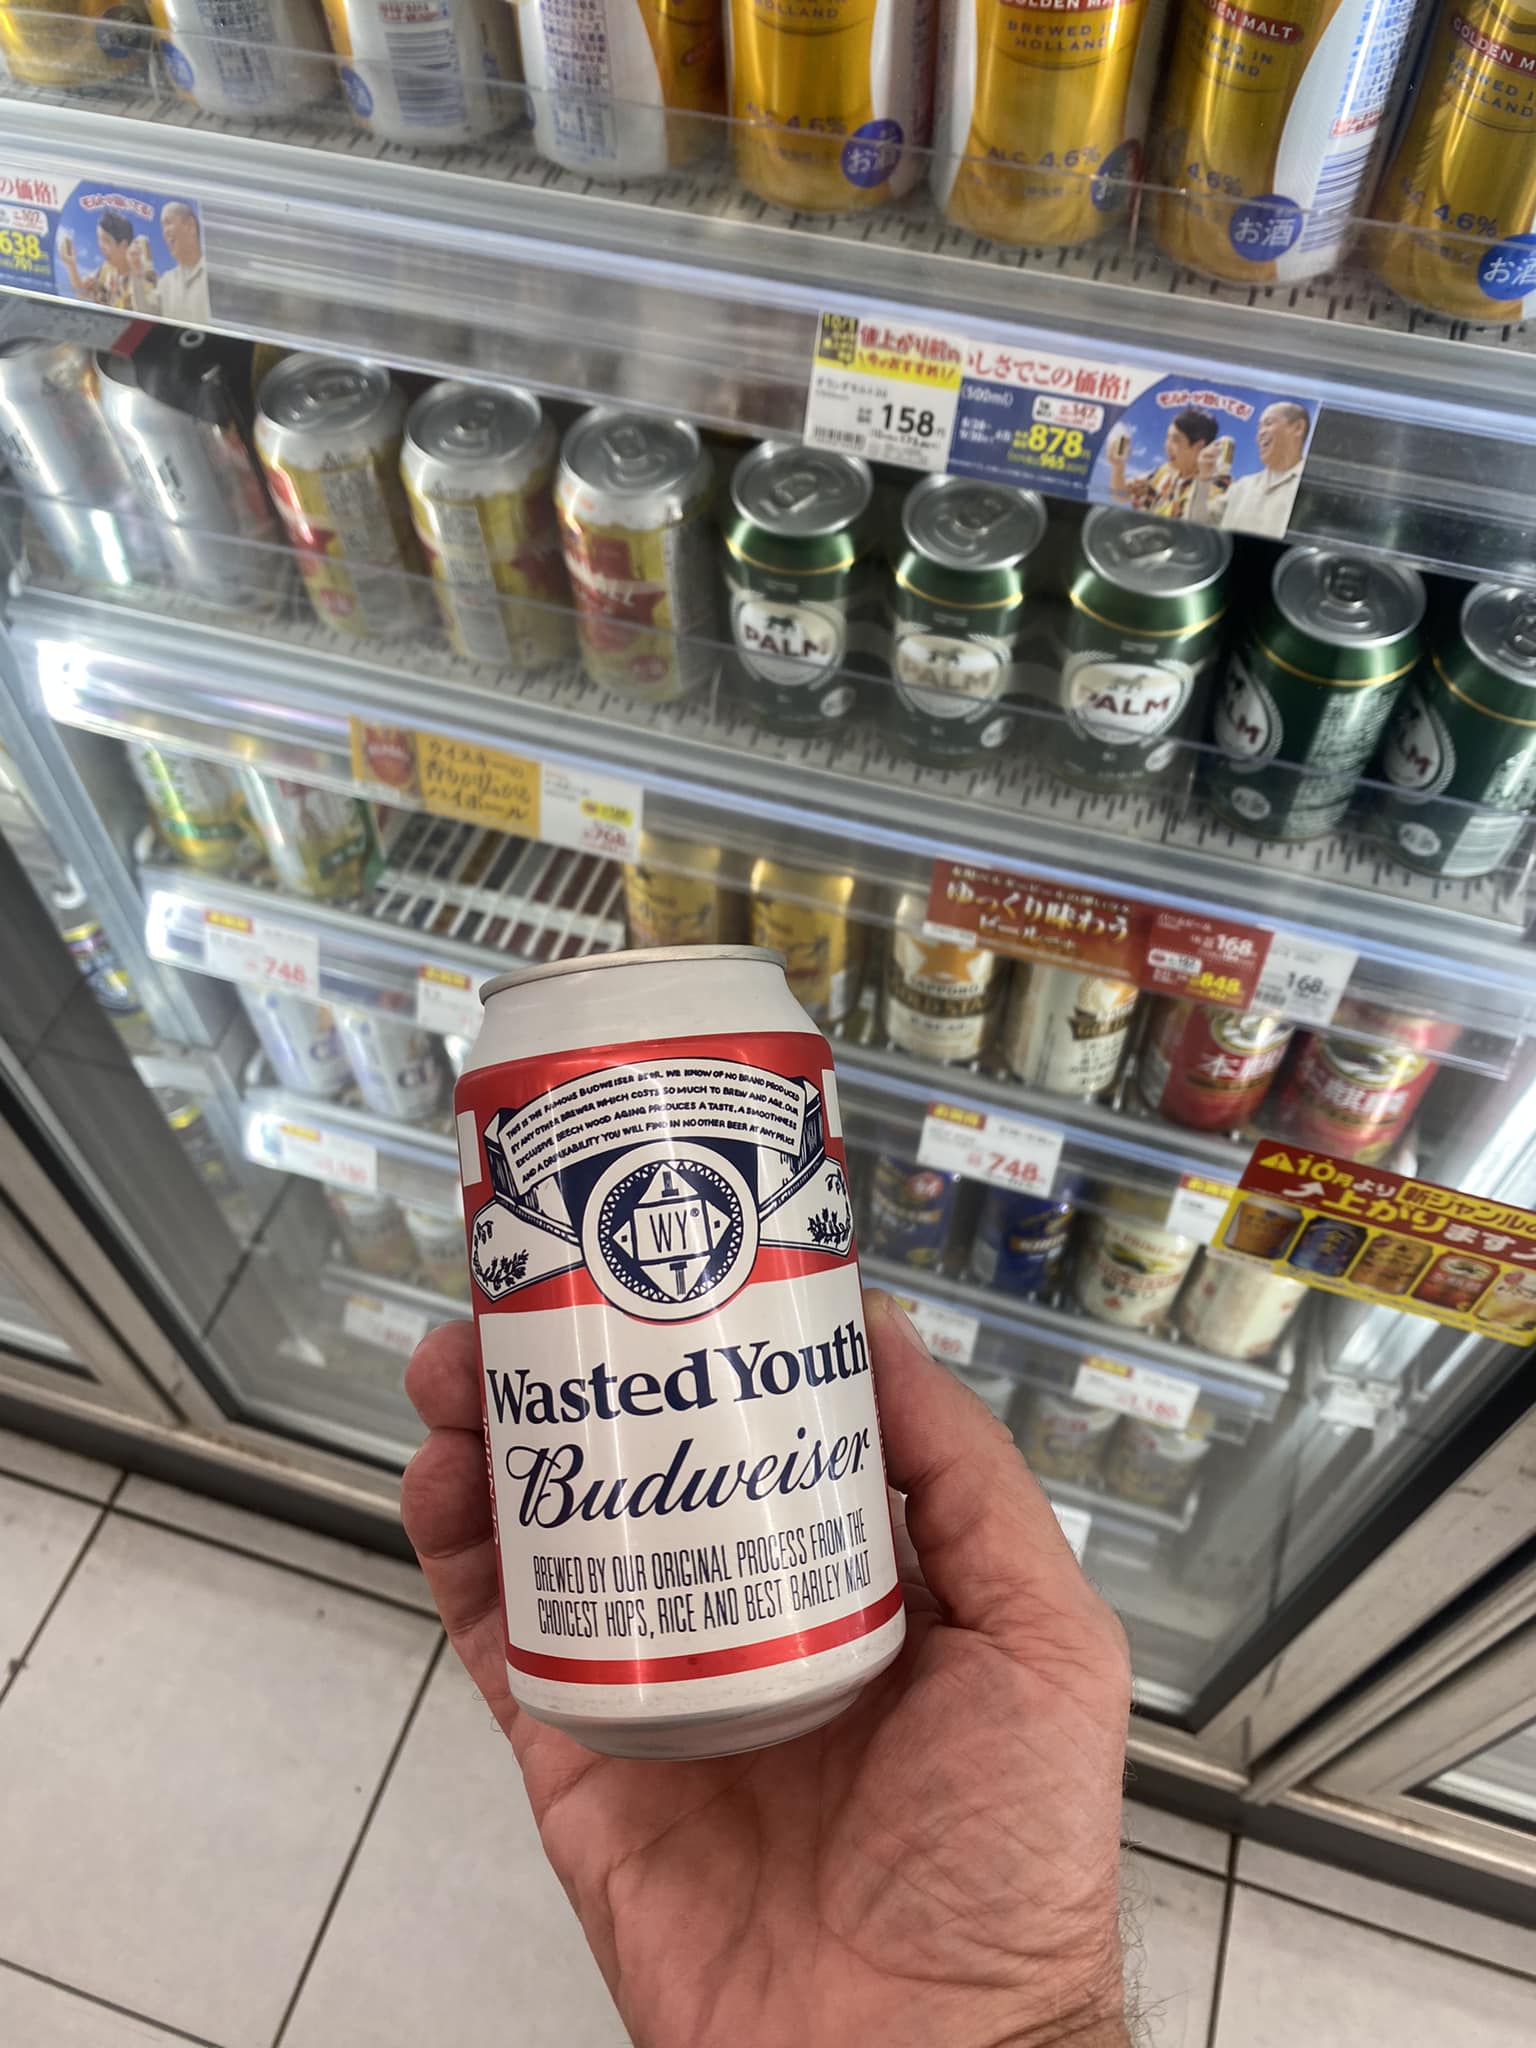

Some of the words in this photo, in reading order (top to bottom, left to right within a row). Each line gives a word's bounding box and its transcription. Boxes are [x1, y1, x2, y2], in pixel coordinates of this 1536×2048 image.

[1008, 20, 1092, 37] BREWED
[1242, 15, 1293, 39] MALT
[1453, 17, 1514, 63] GOLDEN
[1233, 217, 1297, 247] お酒
[1433, 204, 1497, 238] 4.6%
[882, 402, 935, 437] 158
[1028, 424, 1084, 459] 878
[946, 881, 1130, 945] ゆっくり味わう
[506, 1122, 521, 1140] THIS
[522, 1118, 529, 1128] IS
[528, 1108, 543, 1124] THE
[544, 1092, 578, 1113] FAMOUS
[579, 1075, 635, 1097] BUDWEISER
[665, 1069, 681, 1078] WE
[684, 1068, 712, 1077] KNOW
[713, 1070, 724, 1079] OF
[724, 1071, 737, 1081] NO
[738, 1073, 765, 1086] BRAND
[765, 1080, 800, 1101] PRODUCED
[511, 1141, 521, 1155] BY
[520, 1131, 535, 1148] ANY
[535, 1117, 561, 1136] OTHER
[560, 1102, 596, 1122] BREWER
[596, 1093, 630, 1109] WHICH
[631, 1088, 660, 1099] COSTS
[663, 1086, 675, 1096] SO
[676, 1085, 708, 1094] MUCH
[709, 1085, 721, 1094] TO
[722, 1086, 748, 1098] BREW
[749, 1091, 767, 1102] AND
[784, 1104, 799, 1117] OUR
[516, 1139, 555, 1169] EXCLUSIVE
[556, 1124, 584, 1143] BEECH
[584, 1114, 612, 1129] WOOD
[613, 1106, 647, 1121] AGING
[648, 1101, 697, 1114] PRODUCES
[698, 1100, 707, 1109] A
[707, 1102, 737, 1113] TASTE,
[738, 1106, 746, 1114] A
[746, 1107, 797, 1131] SMOOTHNESS
[522, 1167, 537, 1184] AND
[600, 1128, 621, 1143] YOU
[622, 1124, 644, 1136] WILL
[645, 1119, 668, 1132] FIND
[669, 1119, 681, 1128] IN
[682, 1118, 697, 1127] NO
[697, 1118, 726, 1128] OTHER
[727, 1120, 748, 1131] BEER
[749, 1125, 759, 1133] AT
[759, 1127, 776, 1138] ANY
[775, 1132, 795, 1146] PRICE
[988, 1151, 1039, 1184] 748
[1322, 1189, 1517, 1252] 上がります
[487, 1348, 718, 1425] Wasted
[714, 1320, 870, 1404] Youth
[533, 1555, 584, 1594] BREWED
[587, 1557, 606, 1593] BY
[612, 1554, 647, 1593] OUR
[651, 1544, 732, 1590] ORIGINAL
[736, 1527, 807, 1578] PROCESS
[809, 1515, 846, 1560] FROM
[846, 1507, 867, 1547] THE
[537, 1598, 598, 1638] CHOICEST
[604, 1598, 654, 1639] HOPS,
[657, 1593, 697, 1634] RICE
[704, 1587, 739, 1629] AND
[744, 1578, 783, 1622] BEST
[790, 1562, 841, 1611] BARLEY
[844, 1550, 872, 1594] MALT
